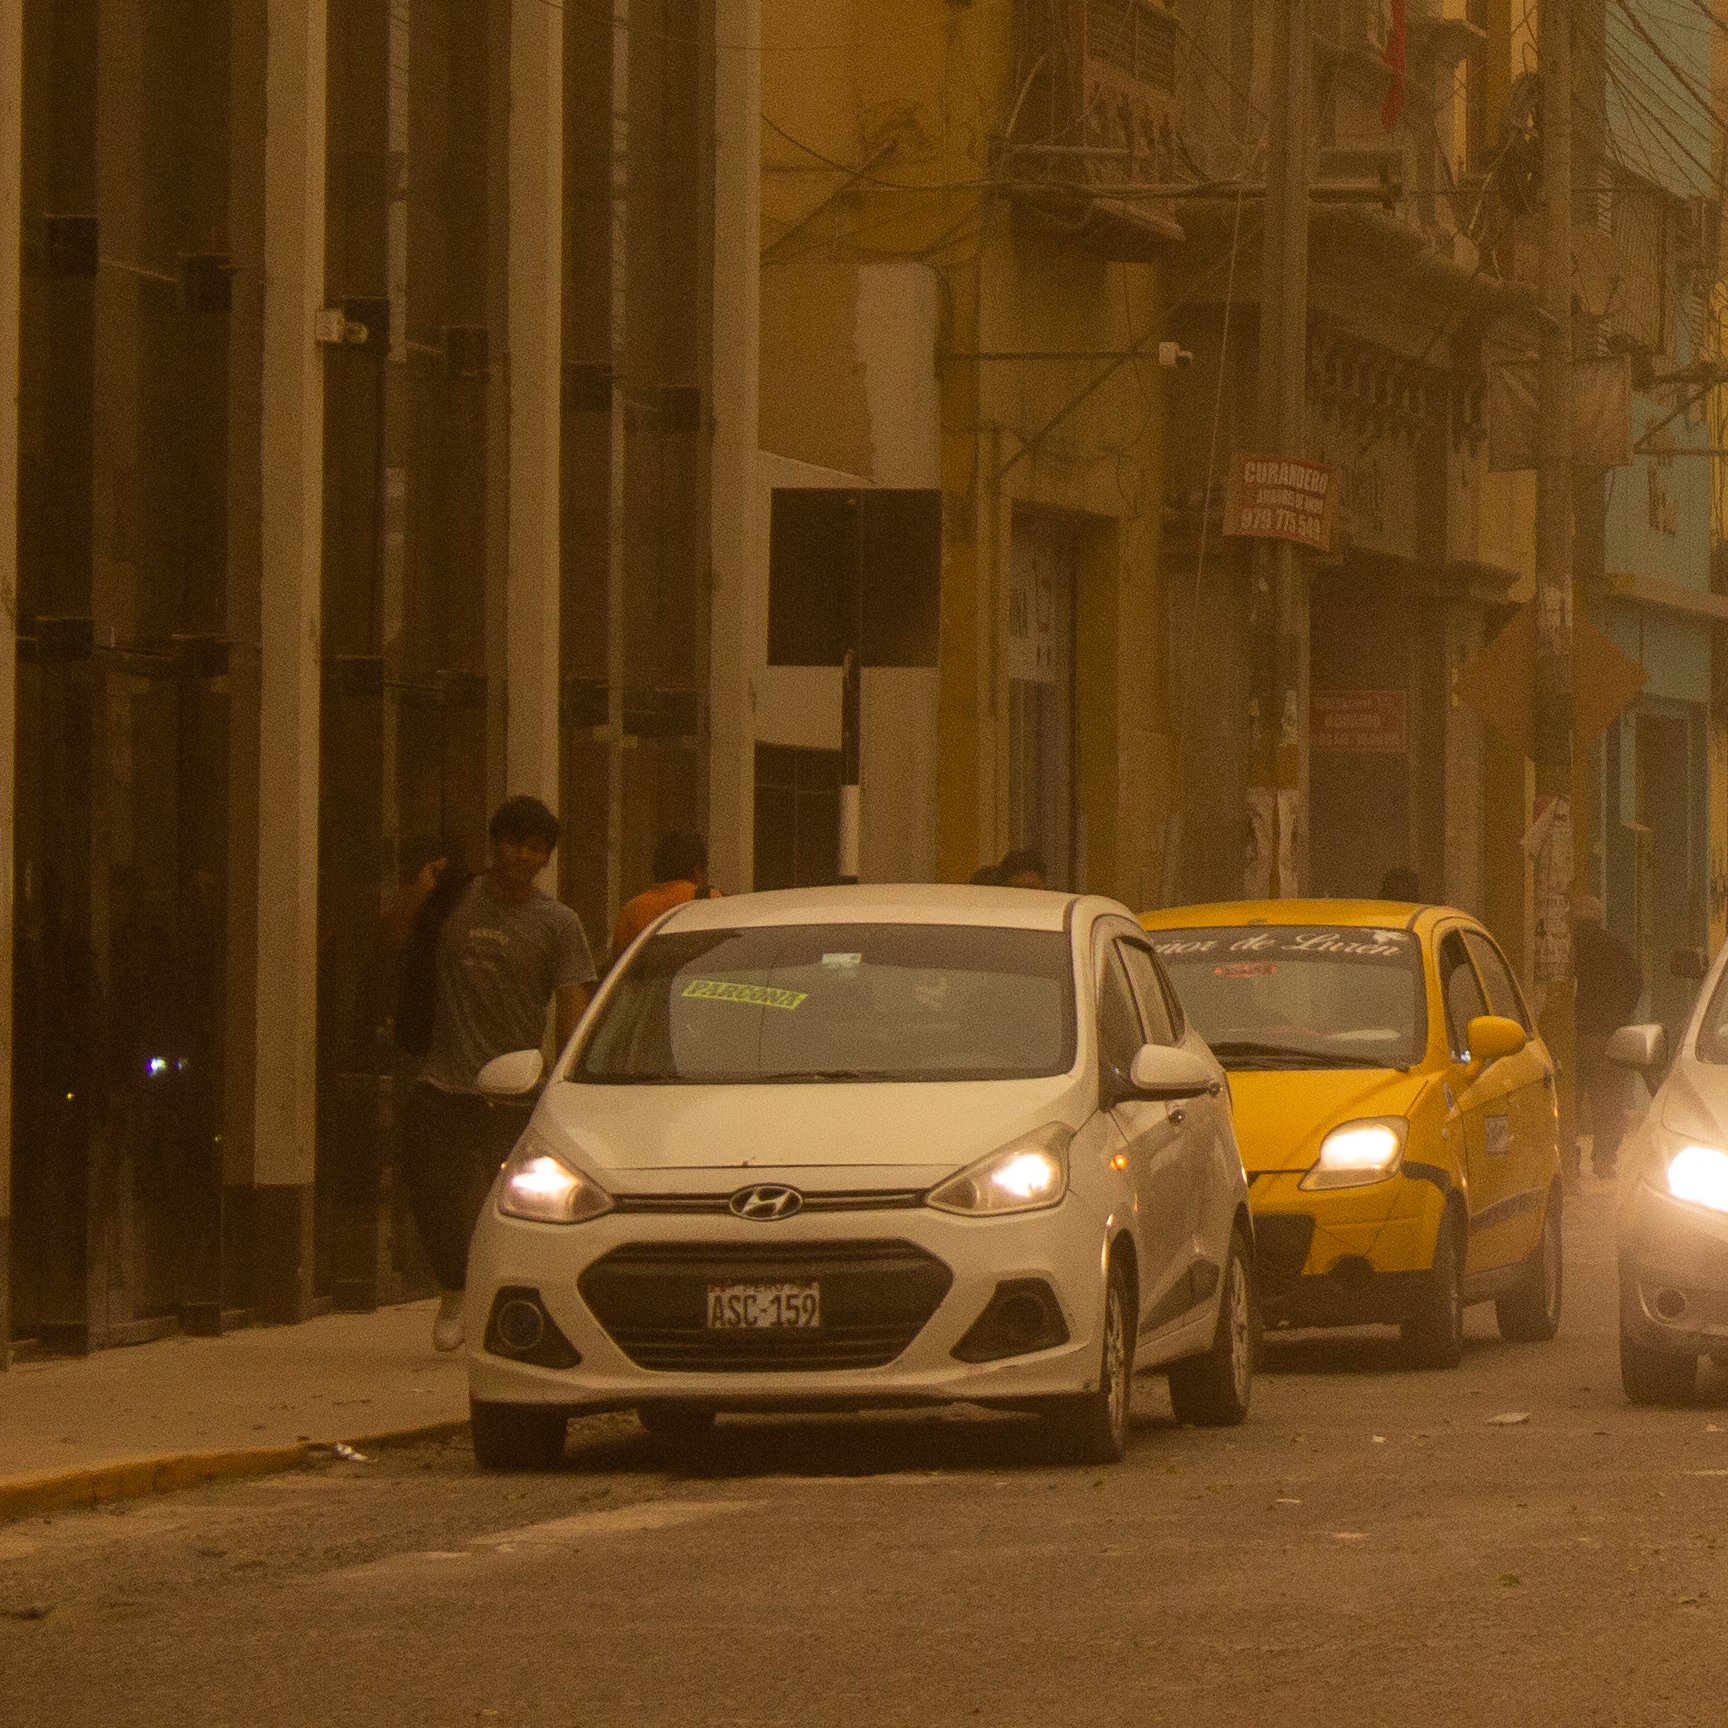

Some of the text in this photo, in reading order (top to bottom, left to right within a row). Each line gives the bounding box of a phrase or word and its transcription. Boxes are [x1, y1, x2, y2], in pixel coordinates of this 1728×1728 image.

[1244, 461, 1329, 495] CURANDERO
[1241, 508, 1272, 530] 979
[1230, 932, 1276, 952] de
[710, 1294, 817, 1328] ASC-159
